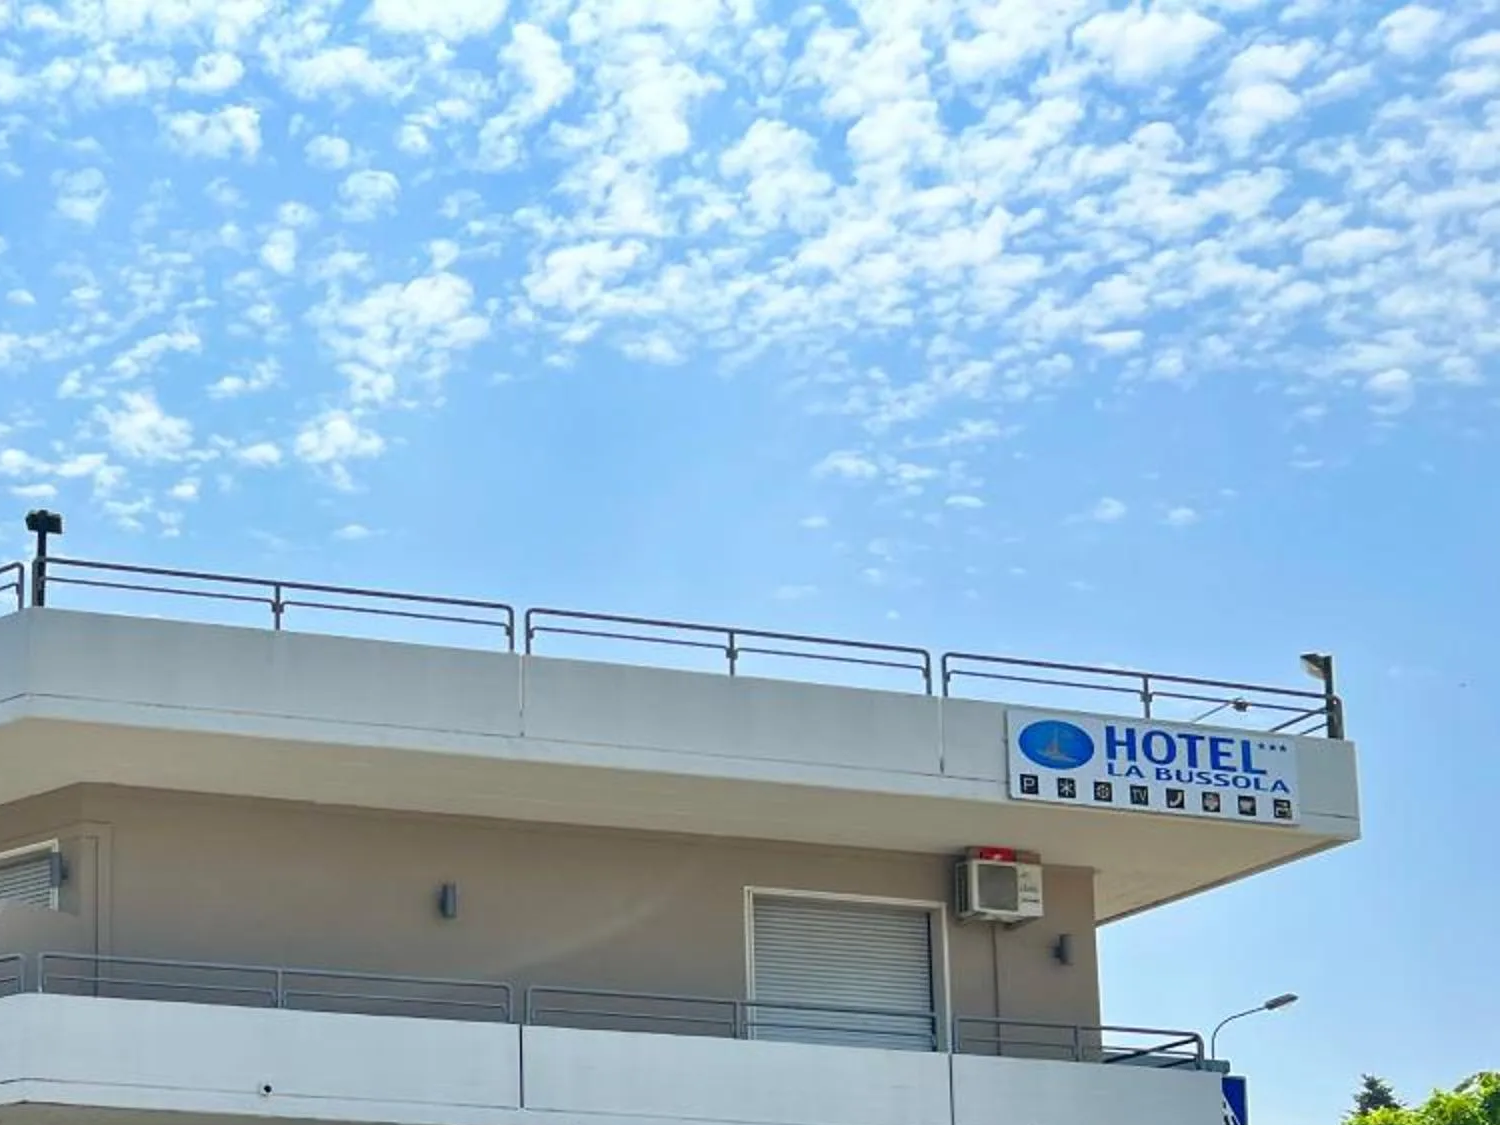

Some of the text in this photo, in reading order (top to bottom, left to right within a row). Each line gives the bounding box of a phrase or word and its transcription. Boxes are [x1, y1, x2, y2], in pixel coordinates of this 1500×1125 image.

[1104, 725, 1267, 775] HOTEL
[1107, 762, 1291, 794] LA BUSSOLA
